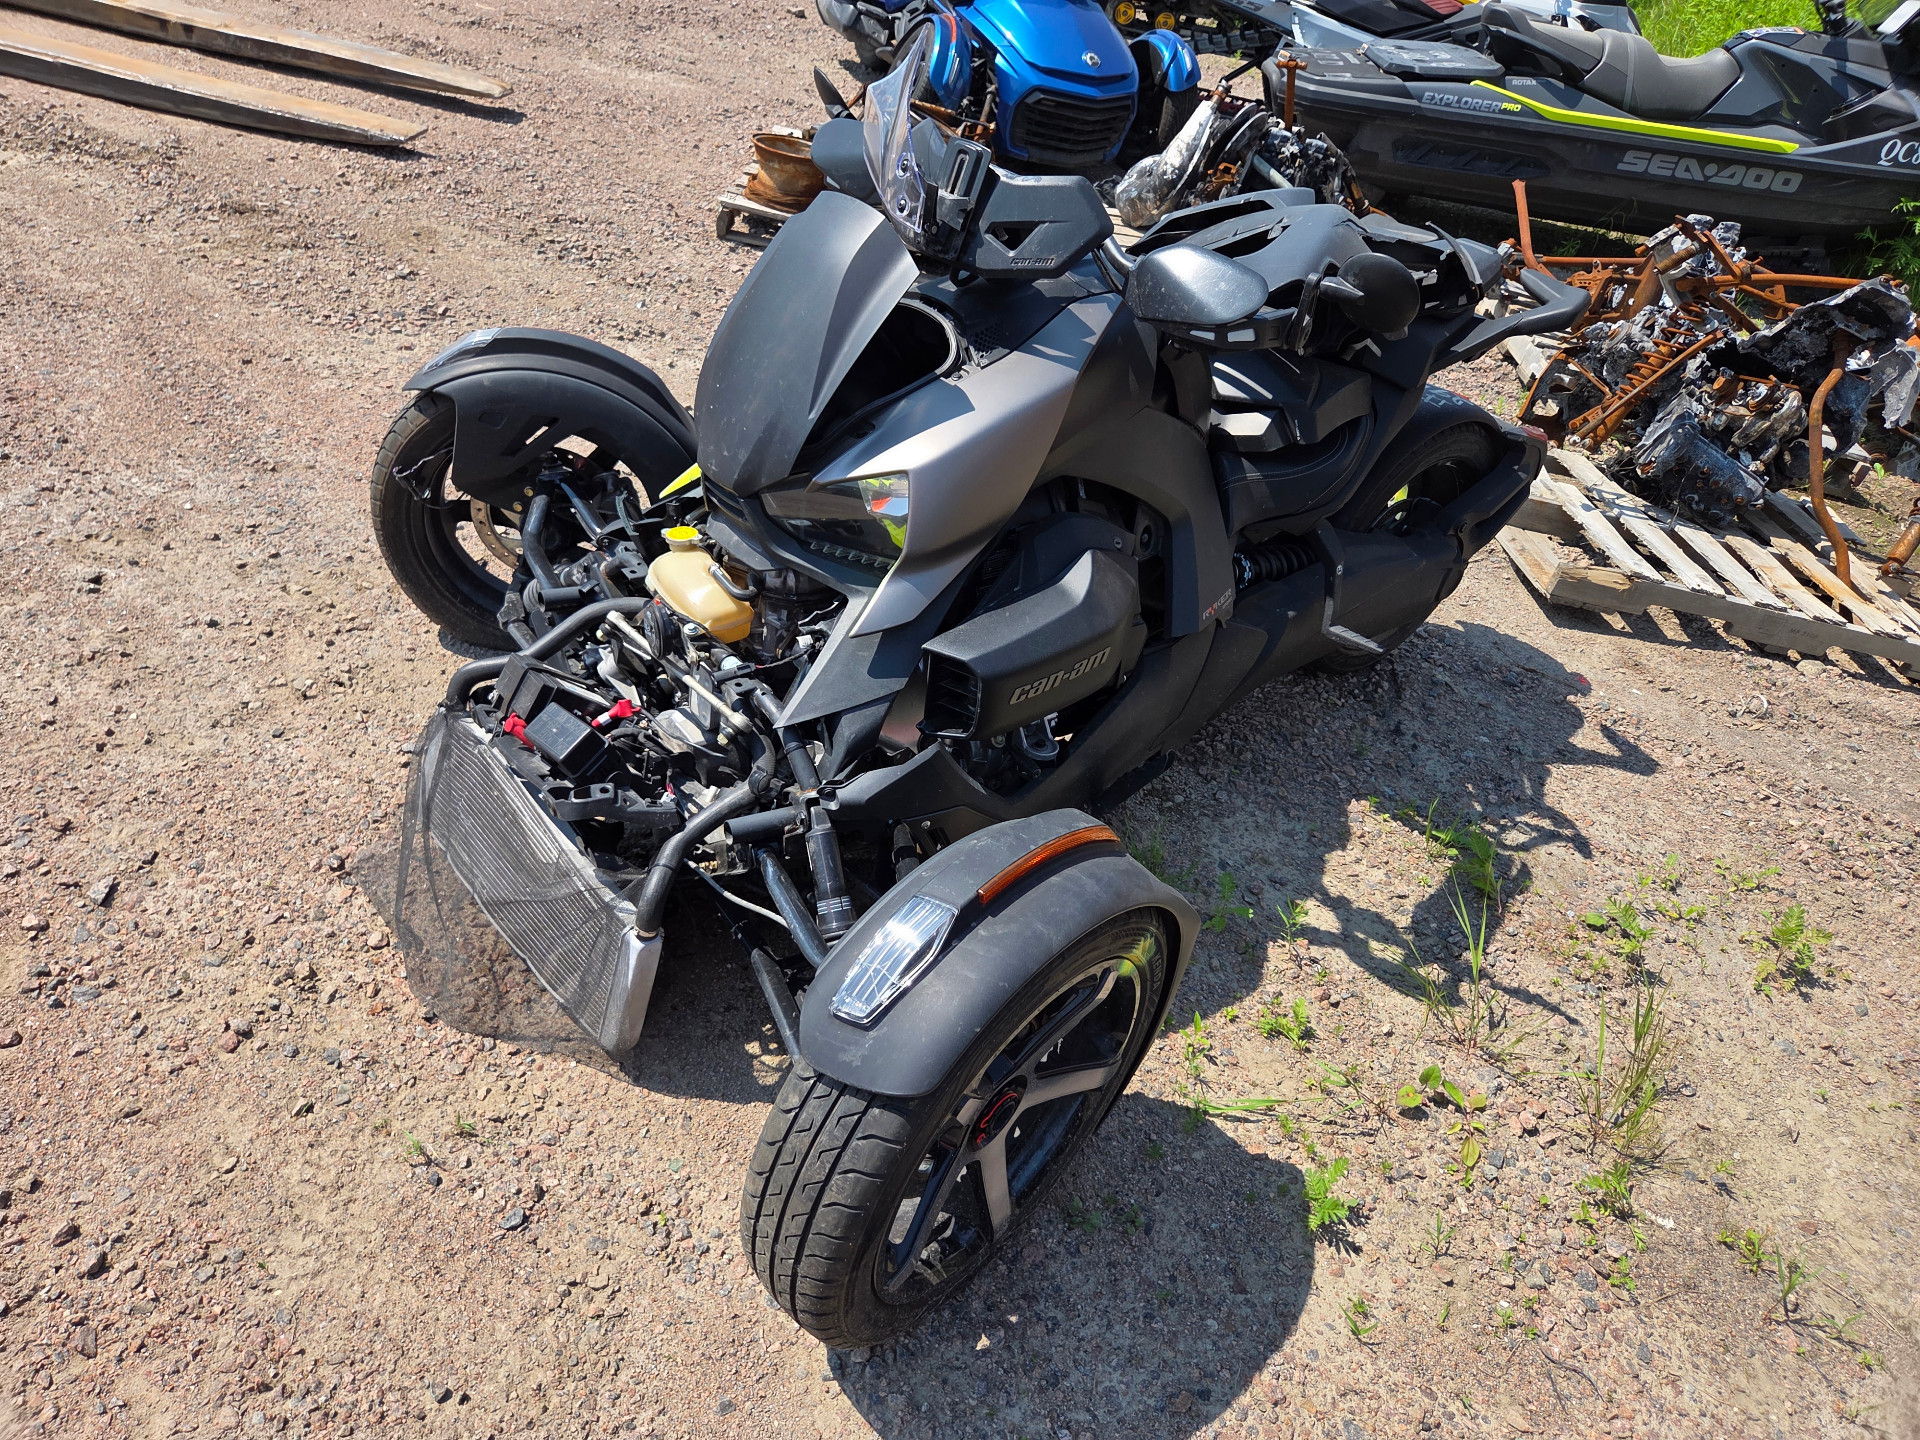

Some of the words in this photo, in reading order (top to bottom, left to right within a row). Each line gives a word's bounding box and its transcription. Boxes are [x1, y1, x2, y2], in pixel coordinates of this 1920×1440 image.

[1421, 91, 1502, 113] EXPLORER
[1501, 102, 1522, 112] PRO
[1009, 646, 1112, 705] can-am
[1151, 952, 1162, 990] KENDA
